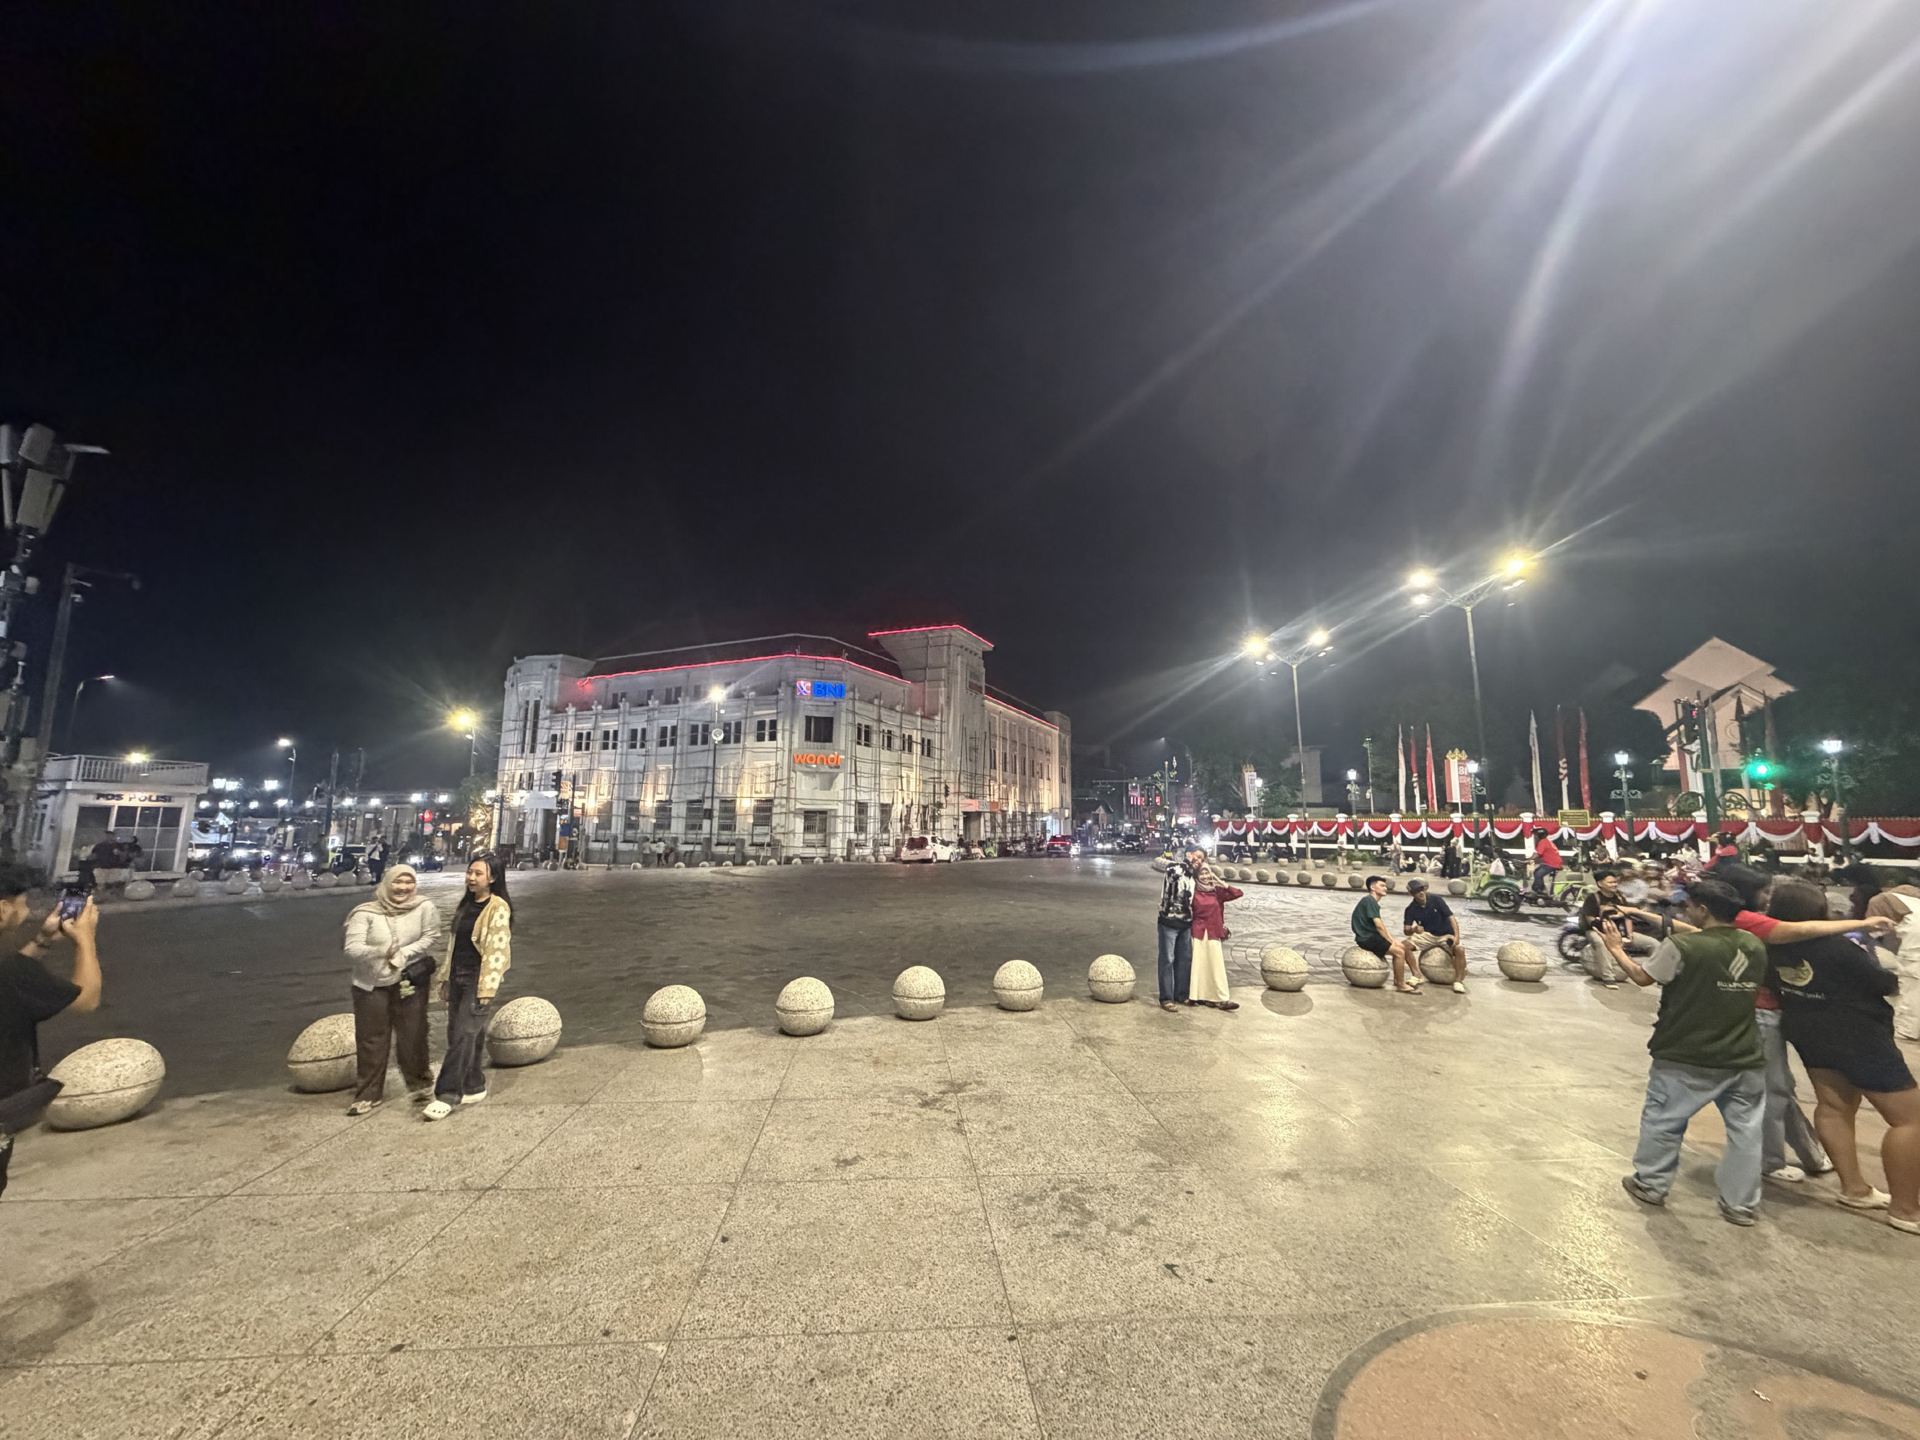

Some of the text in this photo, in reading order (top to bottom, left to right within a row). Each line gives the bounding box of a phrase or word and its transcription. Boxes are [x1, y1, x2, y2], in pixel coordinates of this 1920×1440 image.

[813, 681, 846, 698] BNI
[794, 752, 845, 766] wondr
[96, 792, 173, 803] POS POLISI
